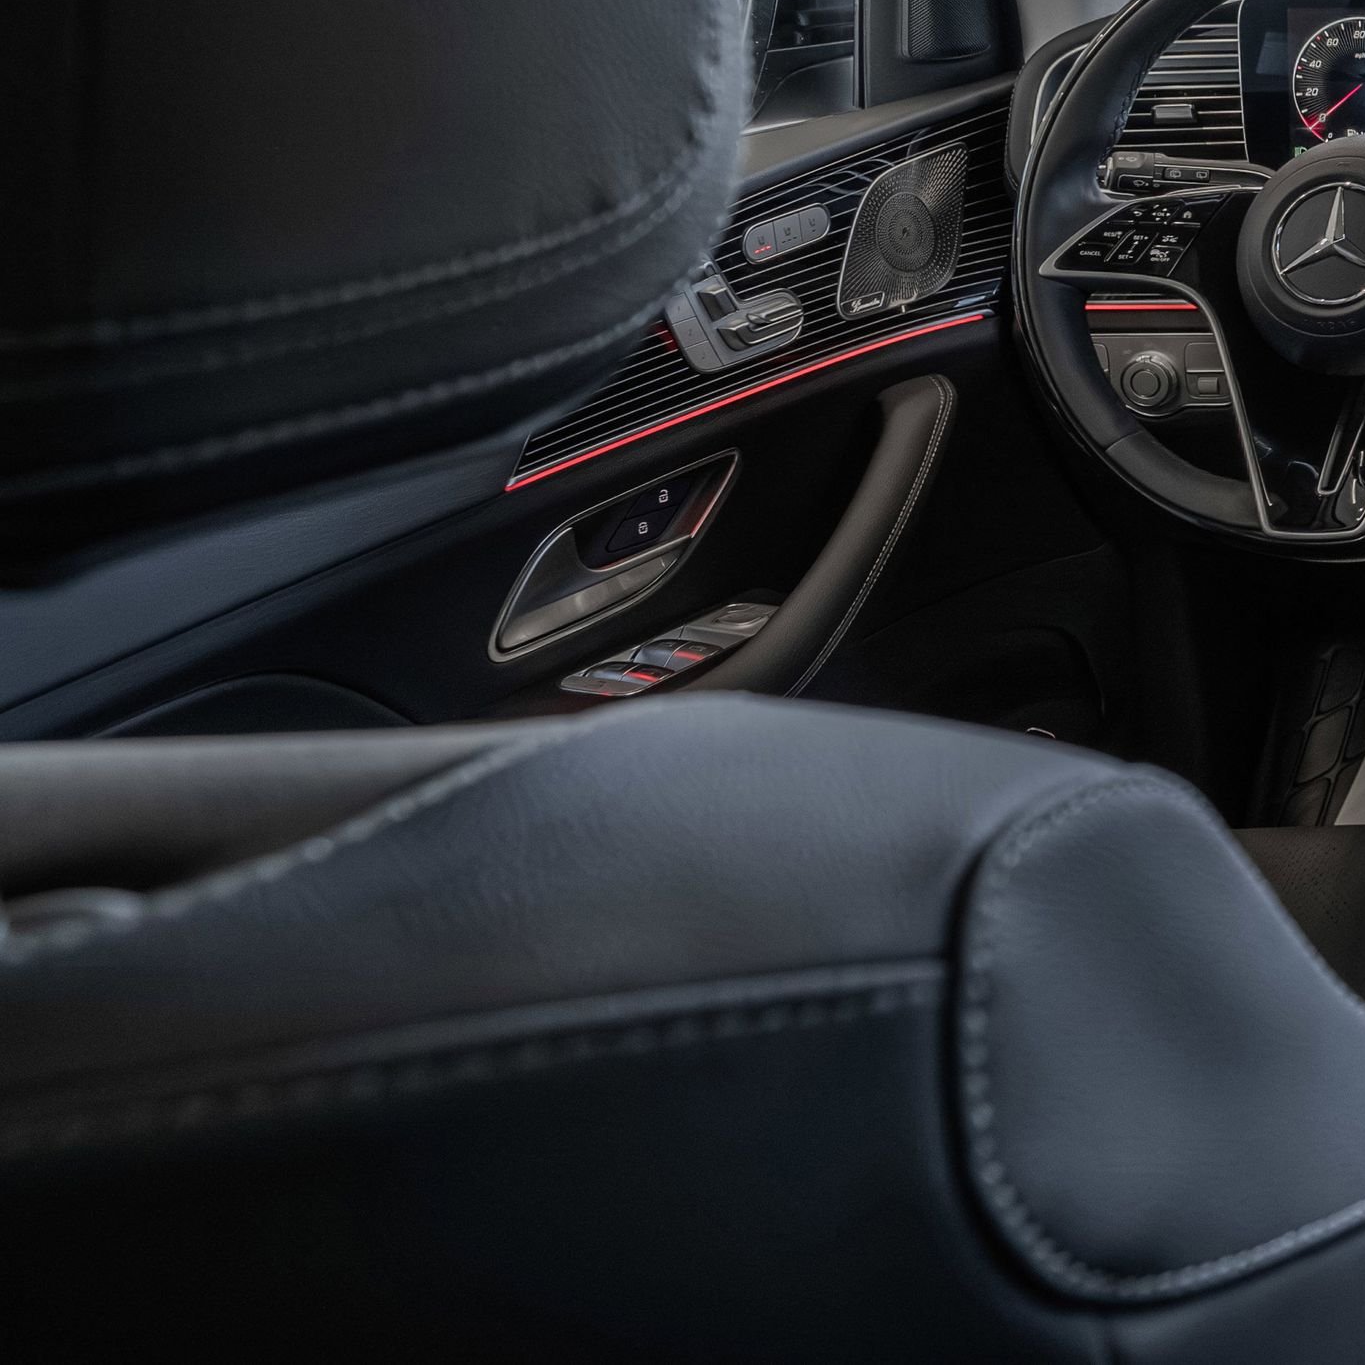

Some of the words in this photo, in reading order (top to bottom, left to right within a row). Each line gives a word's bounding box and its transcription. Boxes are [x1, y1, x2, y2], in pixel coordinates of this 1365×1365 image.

[1353, 30, 1365, 39] 80
[1326, 38, 1339, 46] 60
[1309, 60, 1322, 68] 40
[1305, 88, 1318, 96] 20
[1318, 114, 1327, 122] 0
